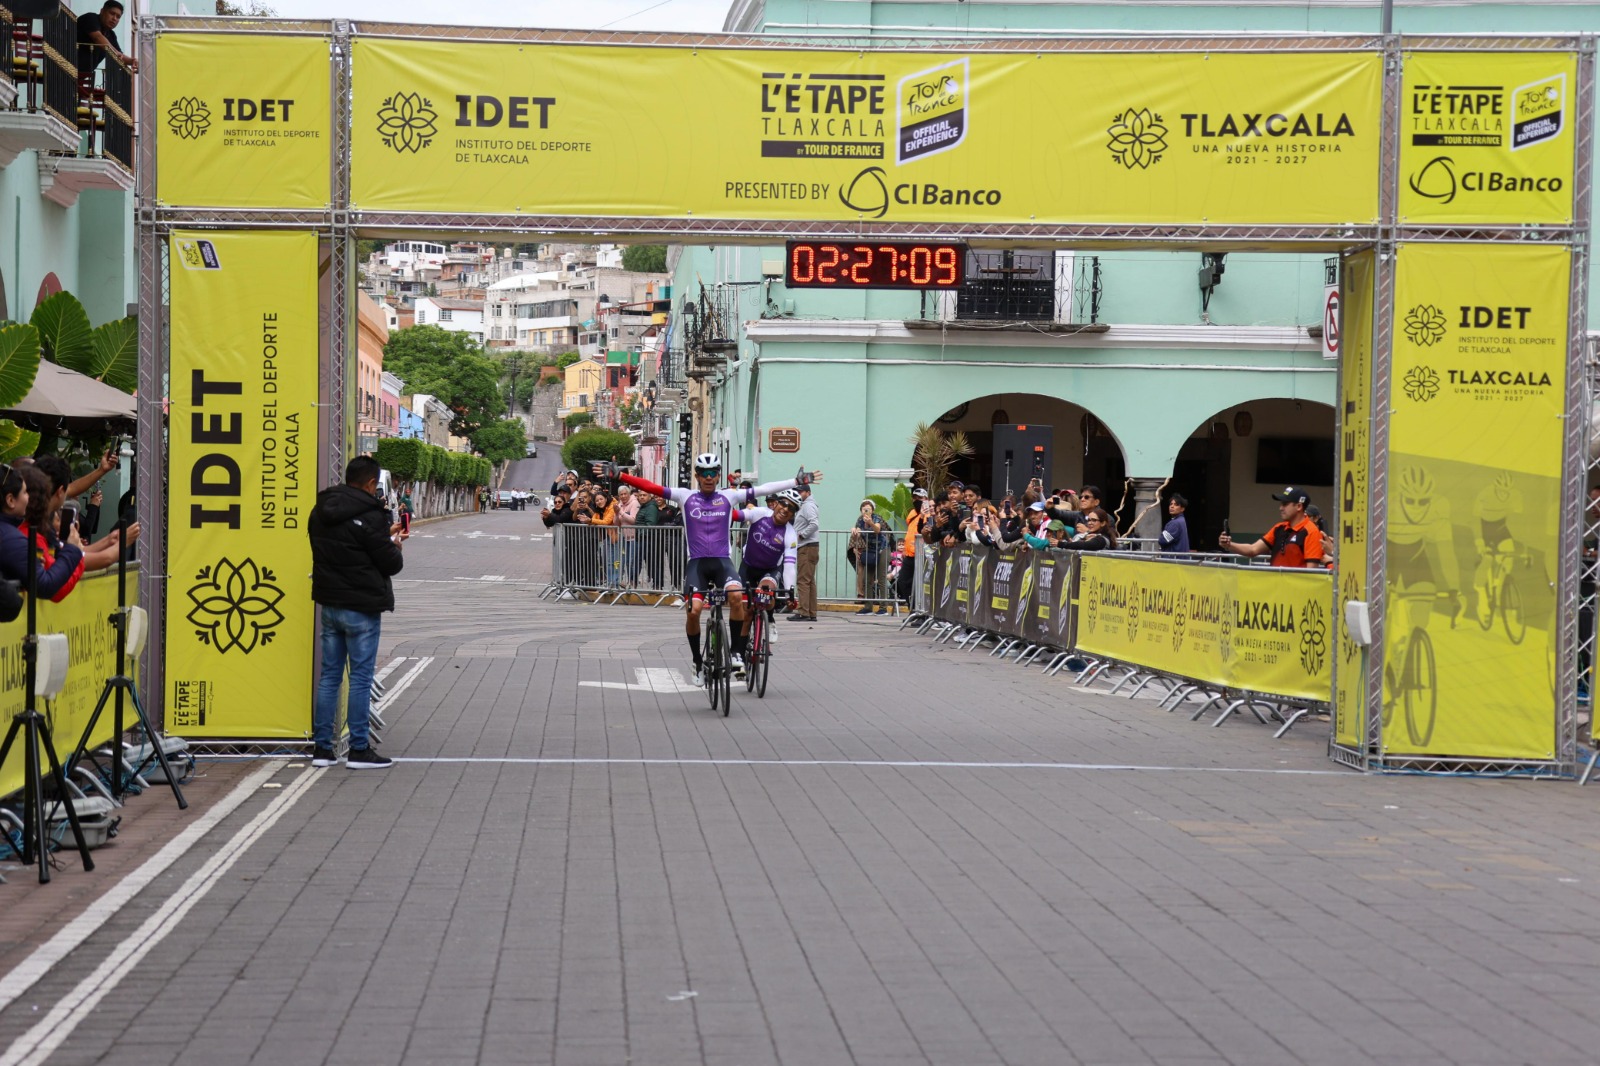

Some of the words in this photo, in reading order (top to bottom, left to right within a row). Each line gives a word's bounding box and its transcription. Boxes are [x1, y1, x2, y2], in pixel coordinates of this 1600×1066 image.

[223, 98, 295, 122] IDET
[455, 94, 556, 129] IDET
[223, 129, 265, 137] INSTITUTO
[283, 130, 320, 138] DEPORTE
[761, 117, 885, 137] TLAXCALA
[912, 120, 951, 140] OFFICIAL
[1180, 112, 1355, 138] TLAXCALA
[1413, 117, 1503, 131] TLAXCALA
[1516, 123, 1557, 142] EXPERIENCE
[1522, 117, 1552, 132] OFFICIAL
[236, 139, 276, 147] TLAXCALA
[455, 139, 514, 150] INSTITUTO
[516, 141, 538, 151] DEL
[540, 141, 592, 152] DEPORTE
[905, 126, 958, 153] EXPERIENCE
[1192, 144, 1220, 153] UNA
[1226, 144, 1270, 153] NUEVA
[1276, 144, 1342, 153] HISTORIA
[1443, 136, 1463, 145] TOUR
[1463, 136, 1472, 145] DE
[1473, 136, 1501, 145] FRANCE
[455, 153, 470, 163] DE
[473, 153, 529, 164] TLAXCALA
[804, 144, 830, 156] TOUR
[830, 145, 843, 156] DE
[844, 145, 881, 156] FRANCE
[1226, 156, 1257, 164] 2021
[1276, 156, 1308, 164] 2027
[725, 181, 807, 200] PRESENTED
[811, 183, 831, 200] BY
[1461, 171, 1563, 193] CIBanco
[894, 183, 1002, 206] CIBanco
[792, 245, 957, 284] 02:27:09
[1459, 306, 1532, 329] IDET
[1458, 336, 1500, 344] INSTITUTO
[1471, 346, 1511, 354] TLAXCALA
[263, 312, 278, 394] DEPORTE
[1447, 370, 1552, 386] TLAXCALA
[262, 399, 277, 432] DEL
[190, 369, 243, 530] IDET
[284, 412, 299, 502] TLAXCALA
[261, 437, 276, 529] INSTITUTO
[284, 506, 298, 529] DE
[1100, 582, 1127, 609] TLAXCALA
[1141, 587, 1174, 617] TLAXCALA
[1189, 593, 1220, 625] TLAXCALA
[1233, 600, 1296, 634] TLAXCALA
[1234, 637, 1245, 648] UNA
[1246, 638, 1262, 649] NUEVA
[1263, 639, 1291, 653] HISTORIA
[1244, 651, 1257, 662] 2021
[1263, 653, 1278, 664] 2027
